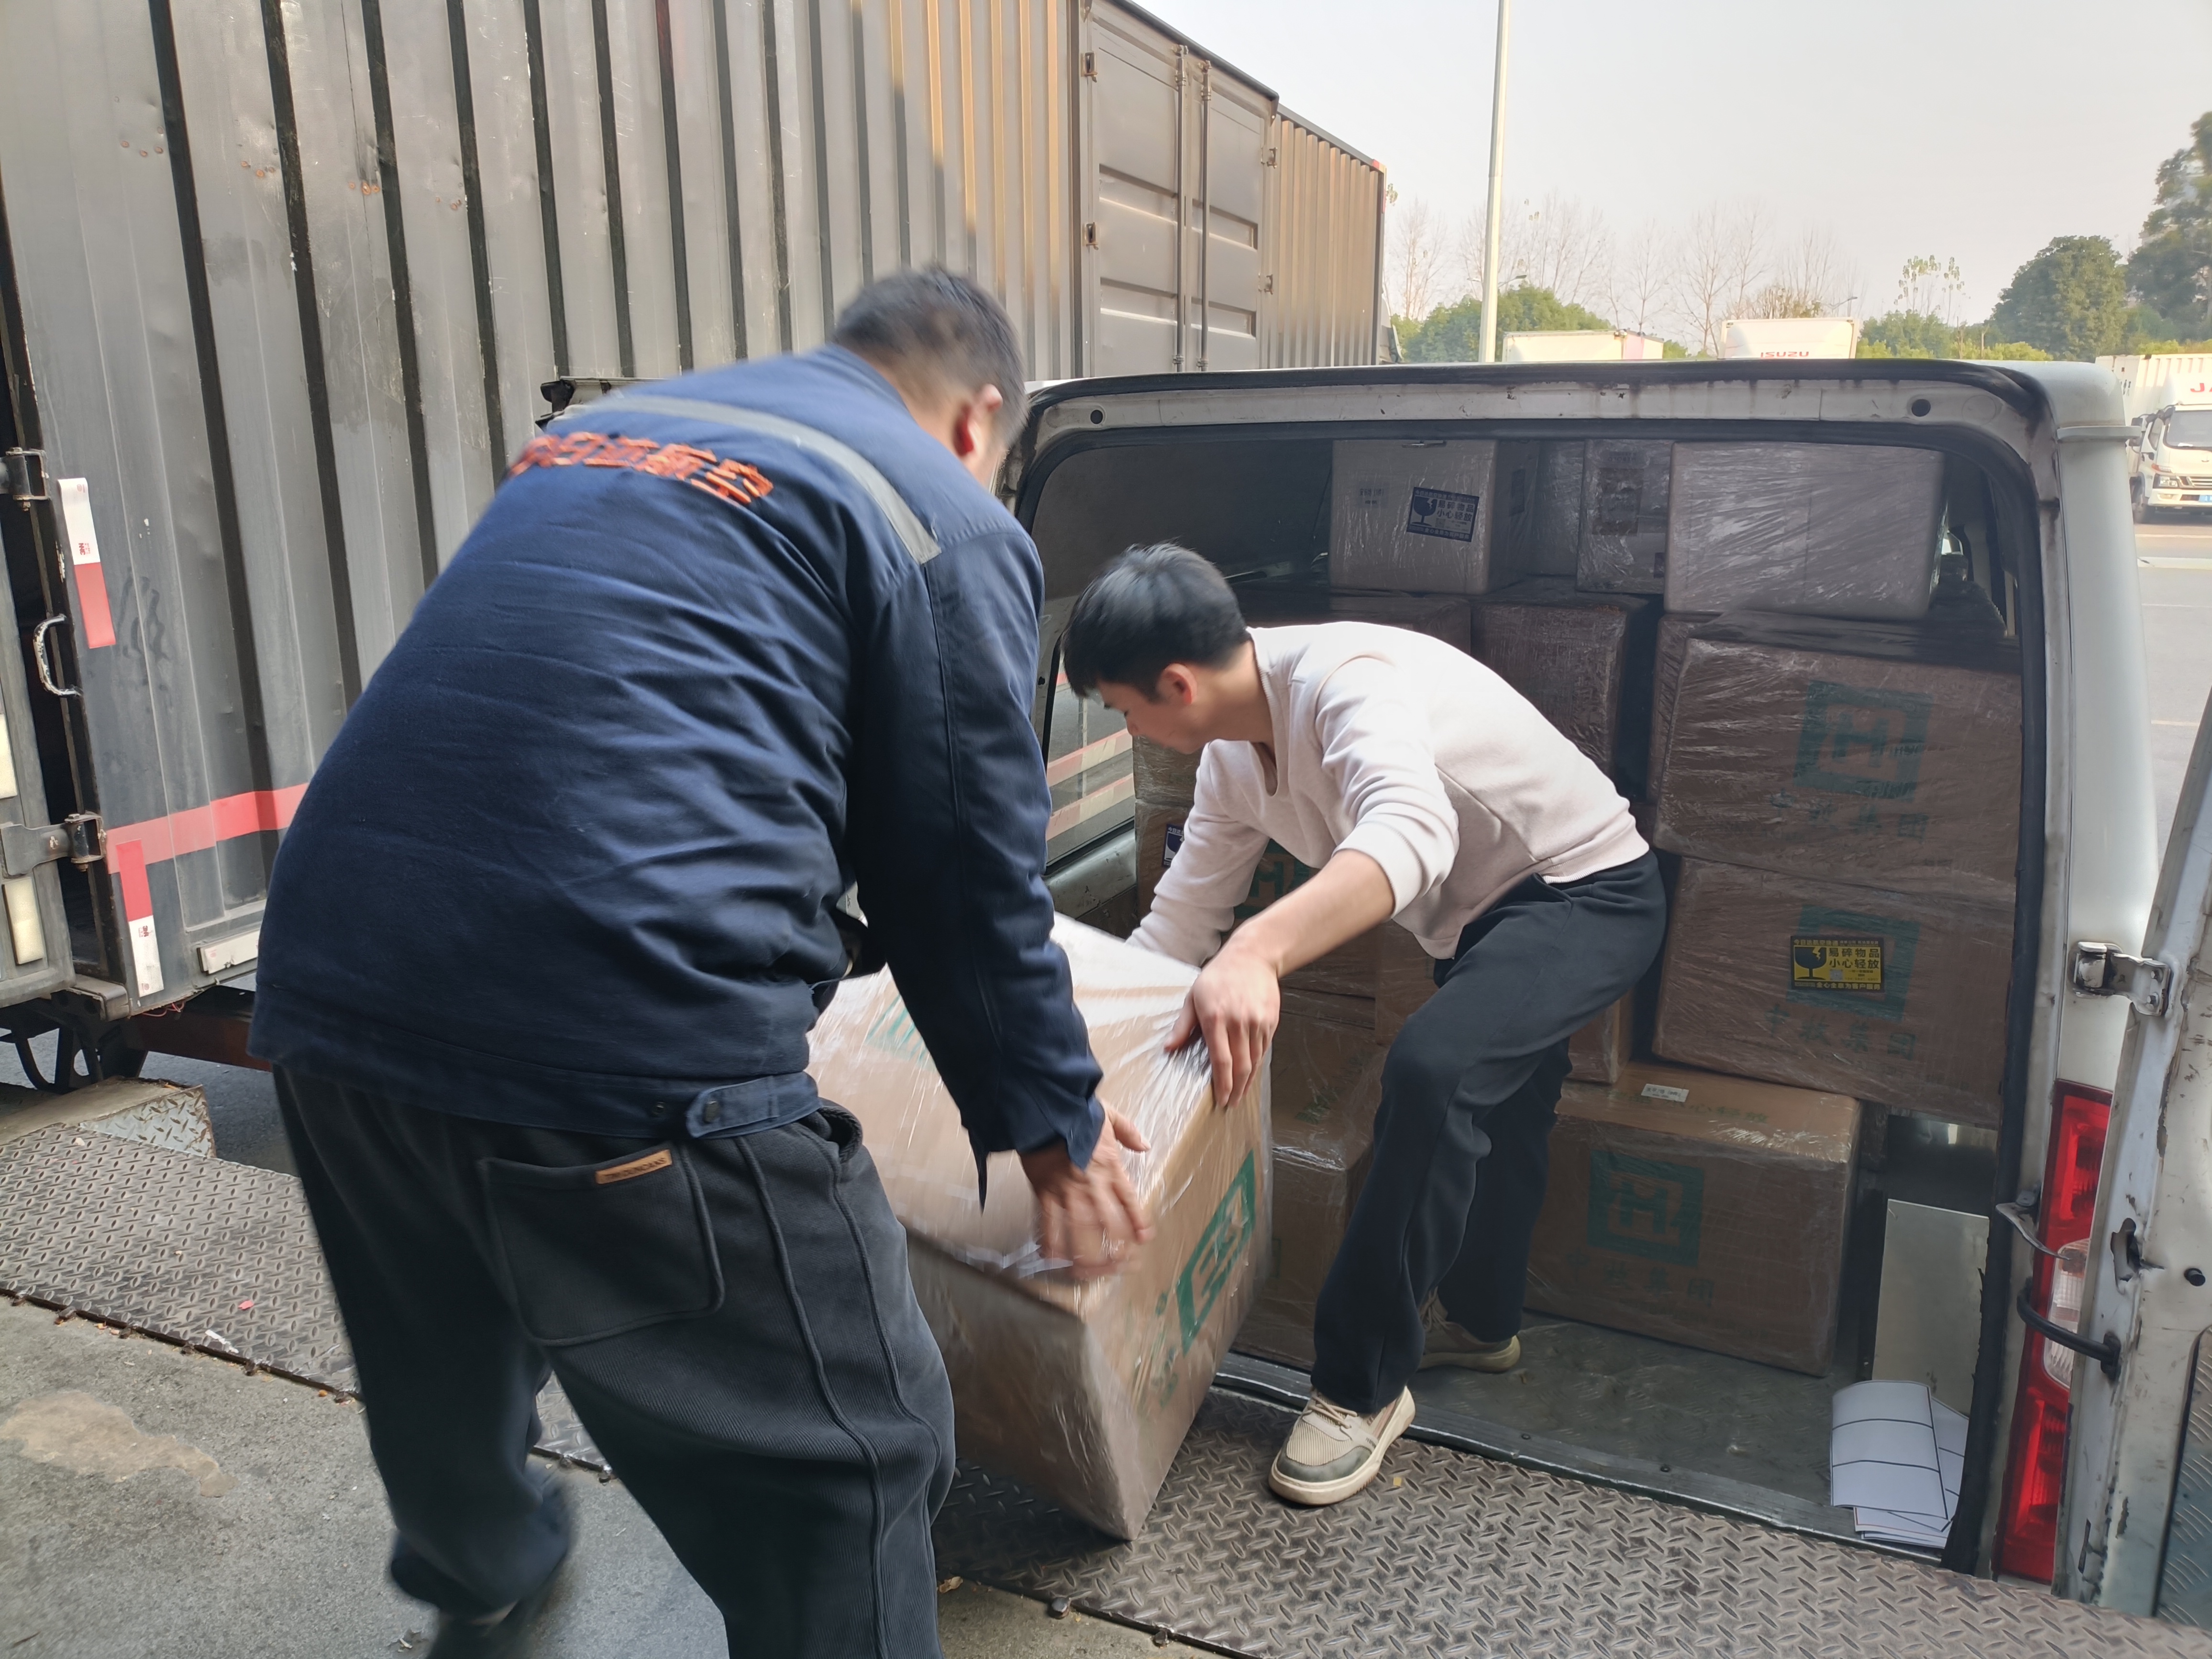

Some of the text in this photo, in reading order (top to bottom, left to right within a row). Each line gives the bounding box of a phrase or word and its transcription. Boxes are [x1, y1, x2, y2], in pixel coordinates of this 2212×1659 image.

[2190, 383, 2212, 393] J
[1437, 499, 1474, 513] 易碎物品
[1436, 509, 1473, 522] 小心轻放
[1828, 947, 1880, 958] 易碎物品
[1828, 958, 1880, 970] 小心轻放
